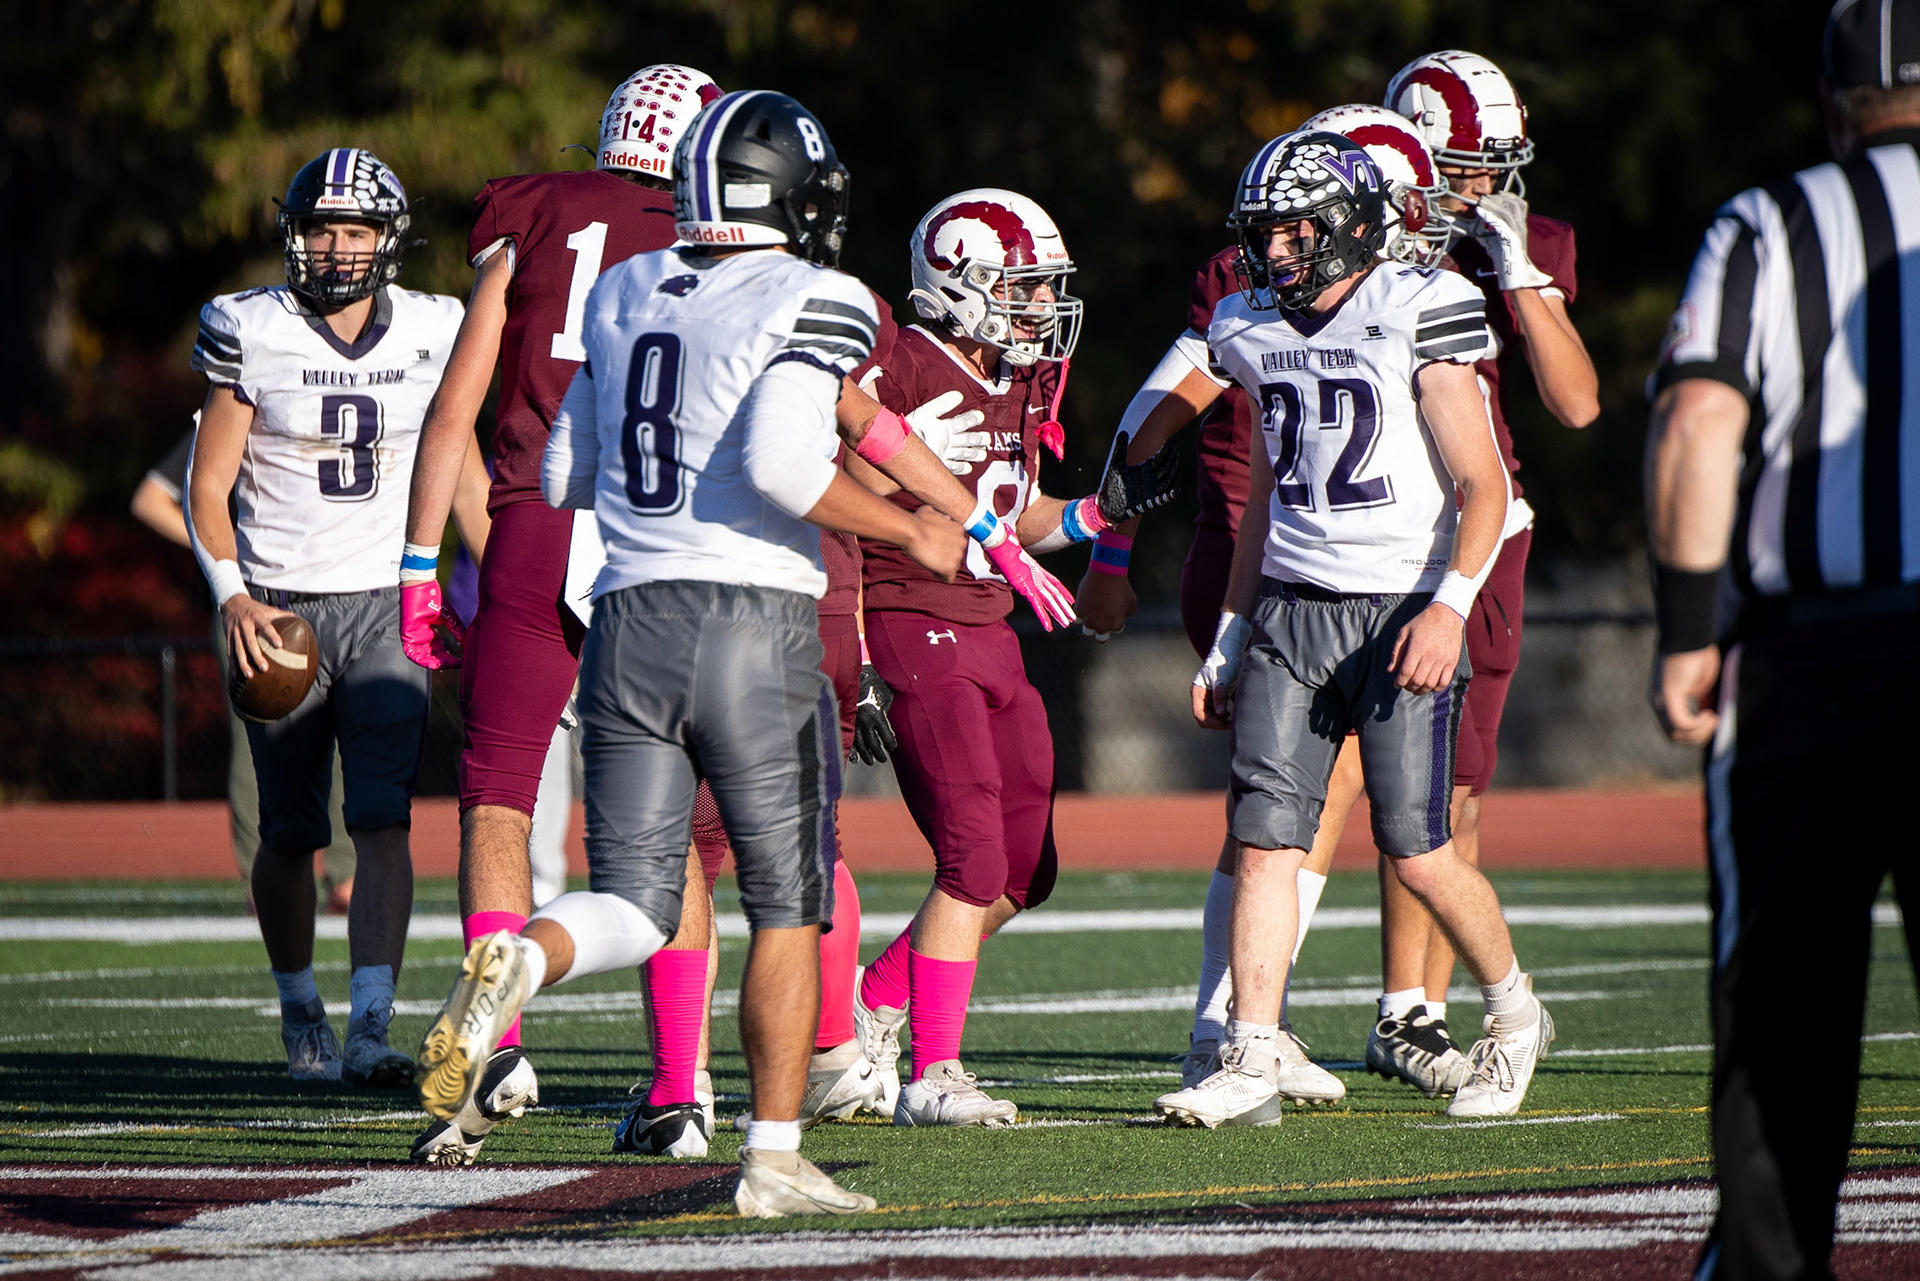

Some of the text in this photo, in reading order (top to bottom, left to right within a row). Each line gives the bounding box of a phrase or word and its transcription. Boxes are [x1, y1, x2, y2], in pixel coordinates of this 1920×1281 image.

[622, 111, 657, 143] 14
[796, 117, 825, 162] 8
[603, 150, 666, 173] Riddell
[1240, 200, 1268, 211] Riddell
[680, 226, 745, 243] Riddell
[1261, 348, 1358, 374] VALLEY TECH
[302, 369, 406, 387] VALLEY TECH
[621, 332, 686, 517] 8
[318, 394, 385, 503] 3
[983, 431, 1022, 451] AMS
[1258, 378, 1397, 514] 22
